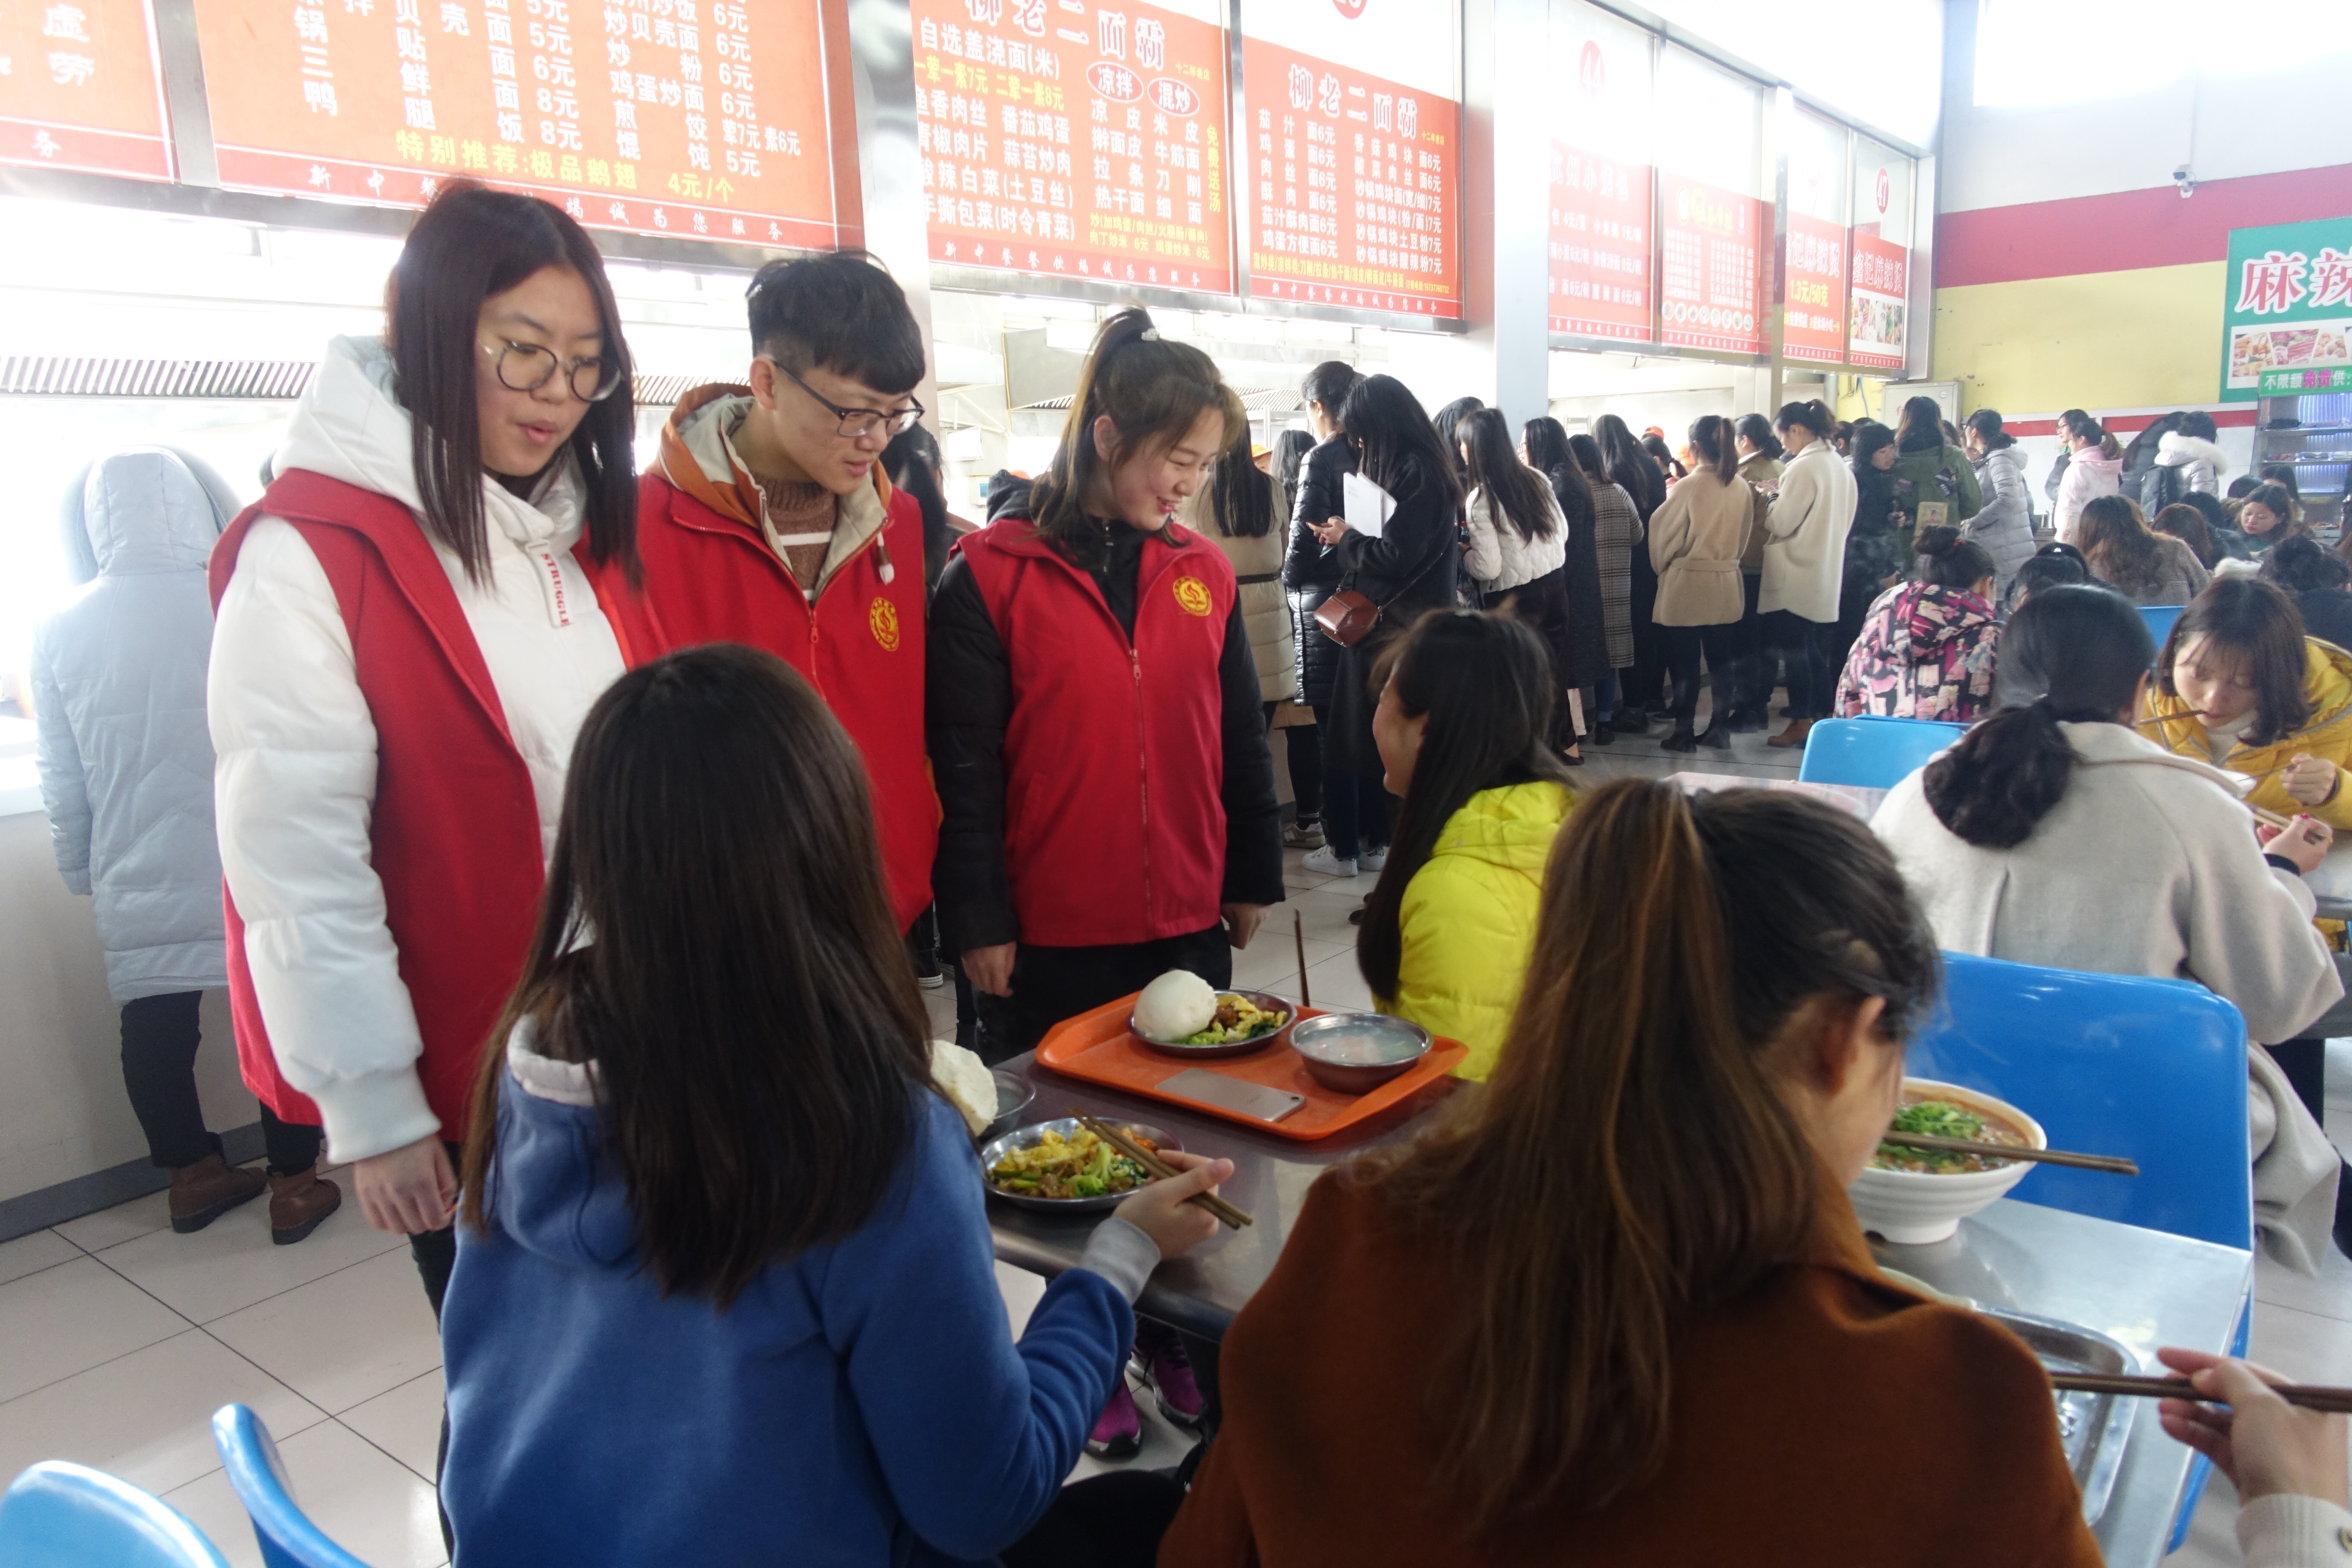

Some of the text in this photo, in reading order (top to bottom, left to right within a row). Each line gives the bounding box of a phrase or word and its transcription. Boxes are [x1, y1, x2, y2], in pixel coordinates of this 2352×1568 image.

[530, 23, 572, 55] 5元
[603, 6, 751, 63] 炒贝壳面 6元
[713, 3, 748, 34] 6元
[606, 37, 753, 92] 炒粉 6元
[920, 17, 1060, 80] 自选盖浇面(米)
[533, 56, 576, 88] 6元
[1097, 66, 1191, 113] 凉拌 混炒
[1175, 61, 1210, 82] 十二年老店
[537, 89, 579, 119] 8元
[609, 70, 756, 121] 鸡蛋炒面 6元
[916, 85, 1070, 145] 鱼香肉丝 番茄鸡蛋
[1289, 63, 1418, 140] 柳老二面霸
[540, 120, 582, 151] 8元
[612, 99, 708, 142] 煎饺
[764, 126, 801, 156] 素6元
[918, 120, 988, 162] 青椒肉片
[1091, 98, 1199, 144] 凉皮 米皮
[616, 130, 761, 178] 馄饨 5元
[1091, 126, 1200, 171] 擀面皮 牛筋面
[1206, 125, 1221, 213] 免费送汤
[668, 173, 735, 203] 4元/个
[1093, 155, 1144, 188] 拉条
[1877, 175, 1888, 207] 47
[1095, 184, 1201, 224] 热干面 细面
[1134, 237, 1149, 252] 6元
[1156, 240, 1191, 257] 鸡蛋炒米
[1197, 244, 1210, 260] 6元
[1549, 242, 1589, 265] 辣小面6元/碗
[2235, 247, 2352, 315] 麻辣
[2264, 368, 2352, 390] 不限额免费供
